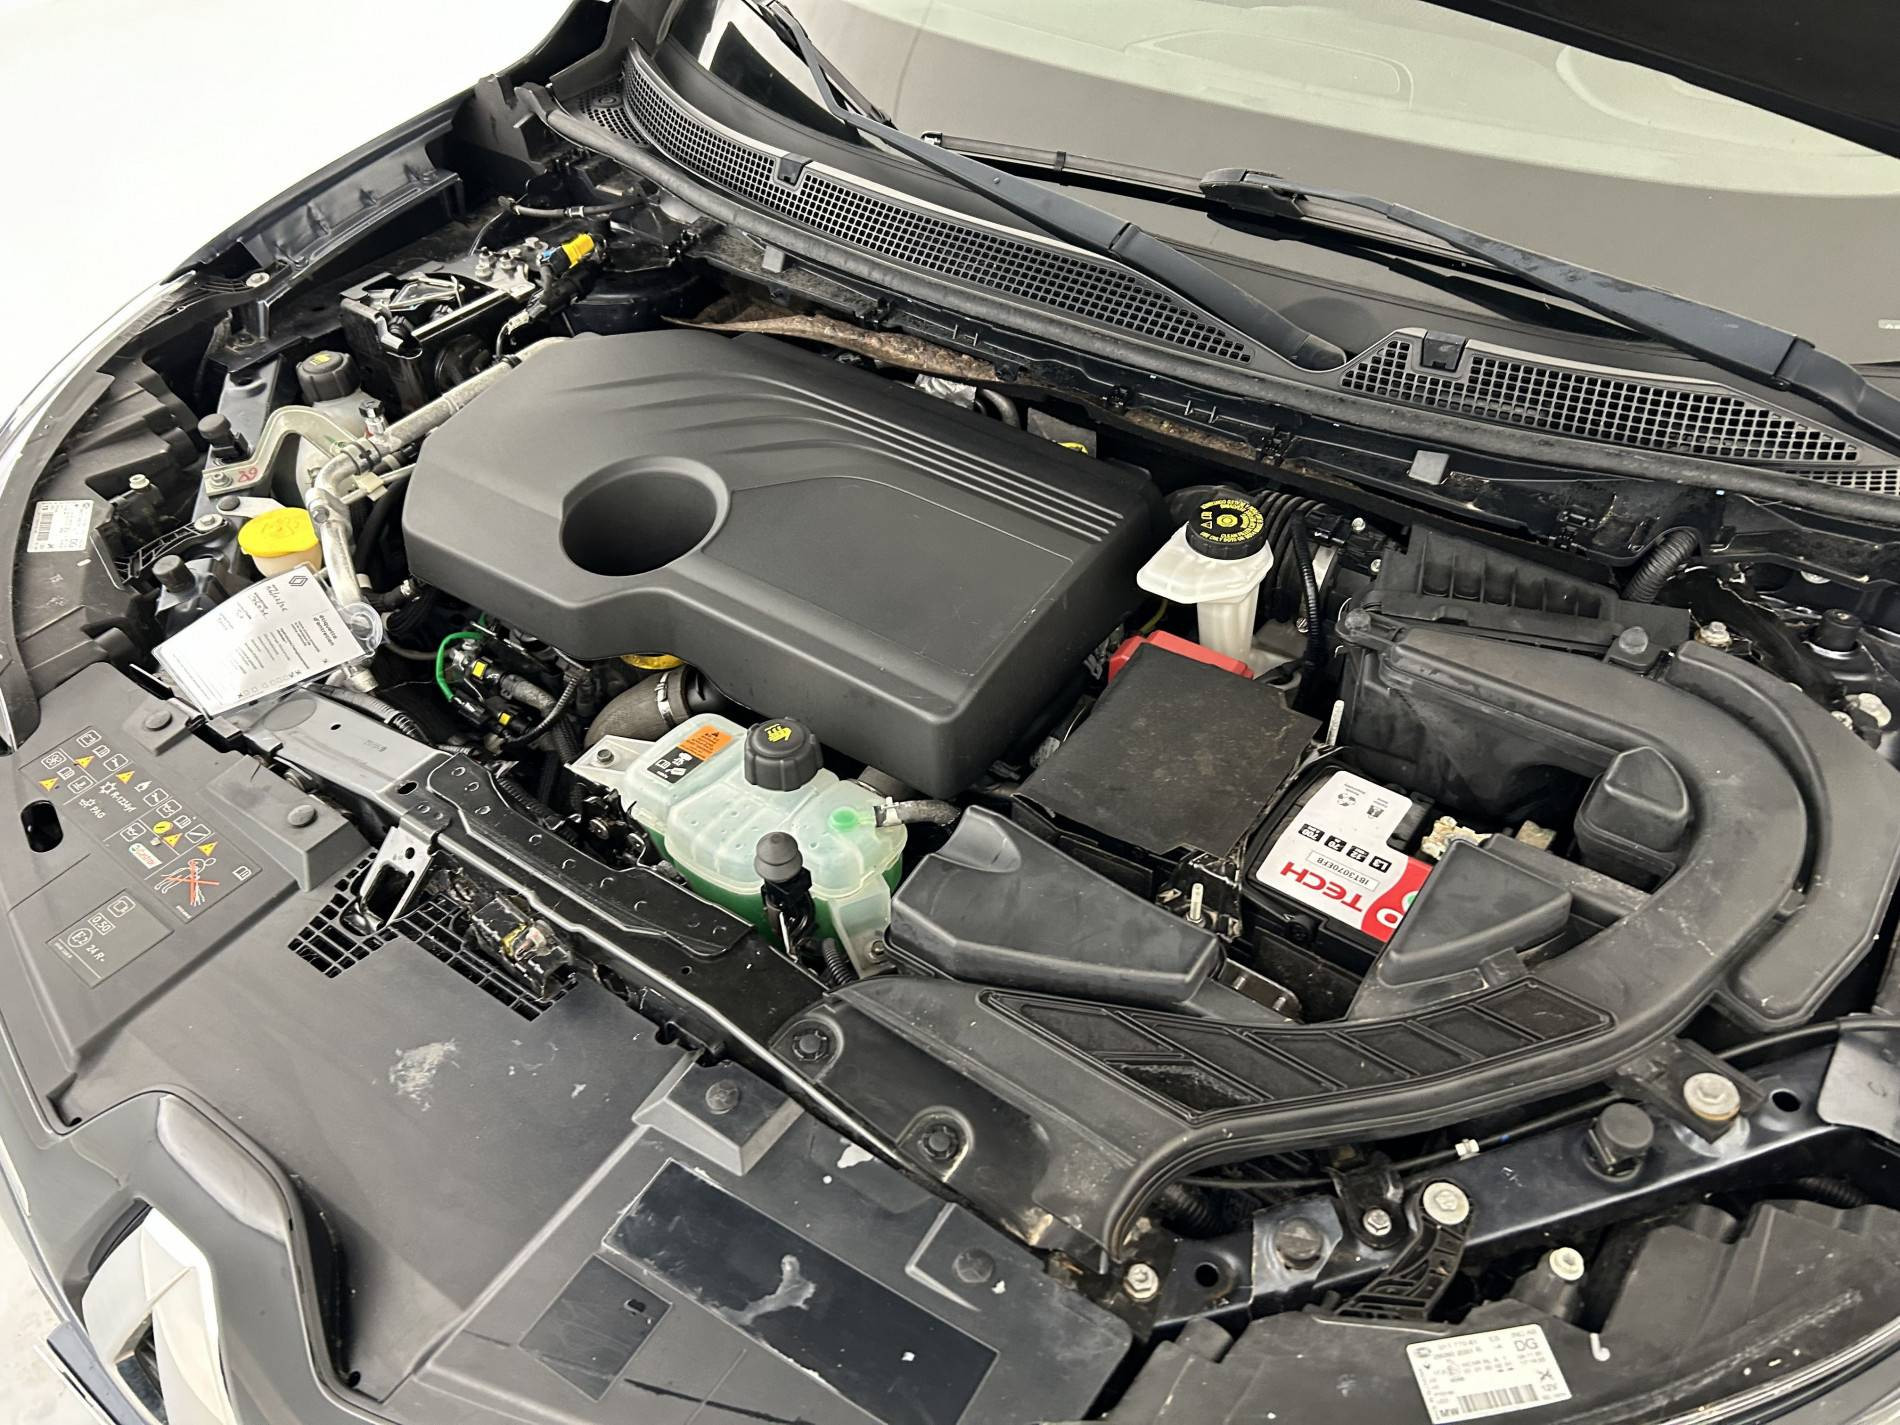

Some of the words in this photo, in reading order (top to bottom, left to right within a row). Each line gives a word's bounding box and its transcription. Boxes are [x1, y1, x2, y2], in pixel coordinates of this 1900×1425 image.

[89, 806, 107, 819] PAG
[1303, 829, 1318, 841] 700
[1327, 842, 1341, 851] 70
[1374, 859, 1387, 870] L3
[1316, 857, 1370, 886] IBT3070EFB
[1280, 861, 1363, 913] TECH
[1514, 1337, 1539, 1351] DG
